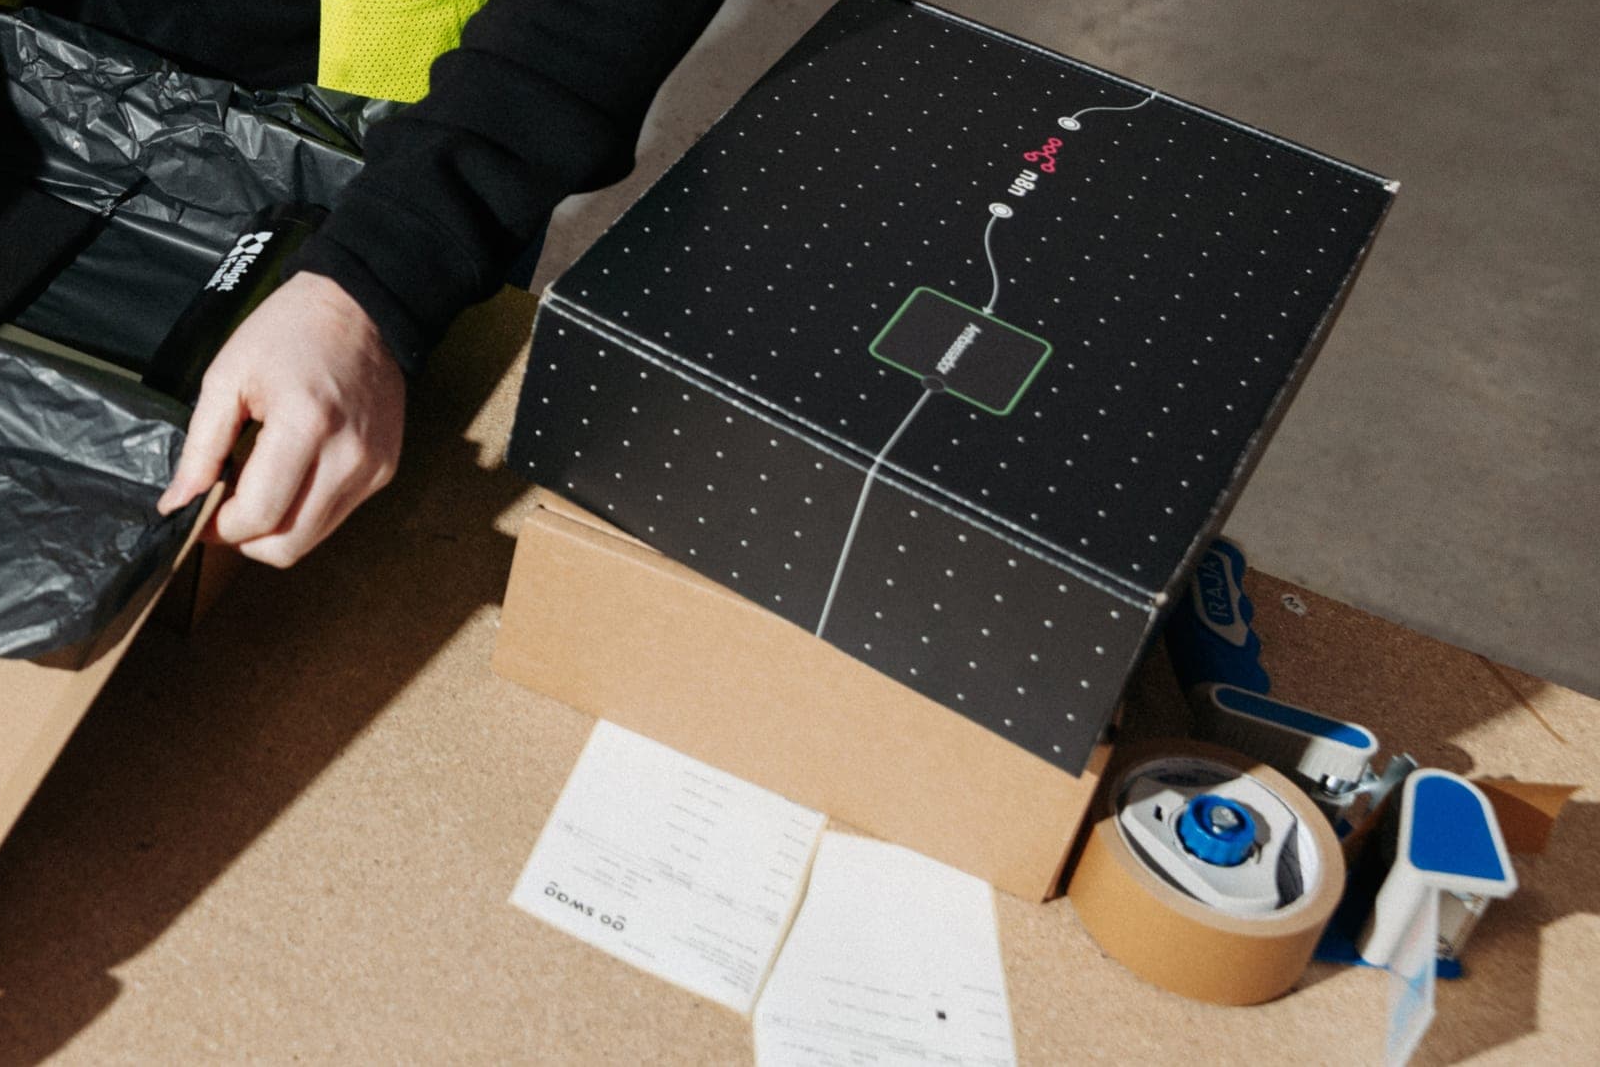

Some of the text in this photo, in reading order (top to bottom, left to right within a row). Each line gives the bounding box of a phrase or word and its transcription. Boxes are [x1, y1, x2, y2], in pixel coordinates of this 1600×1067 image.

[1007, 169, 1039, 196] n8n
[216, 254, 257, 292] Knight
[544, 880, 627, 932] go swag
